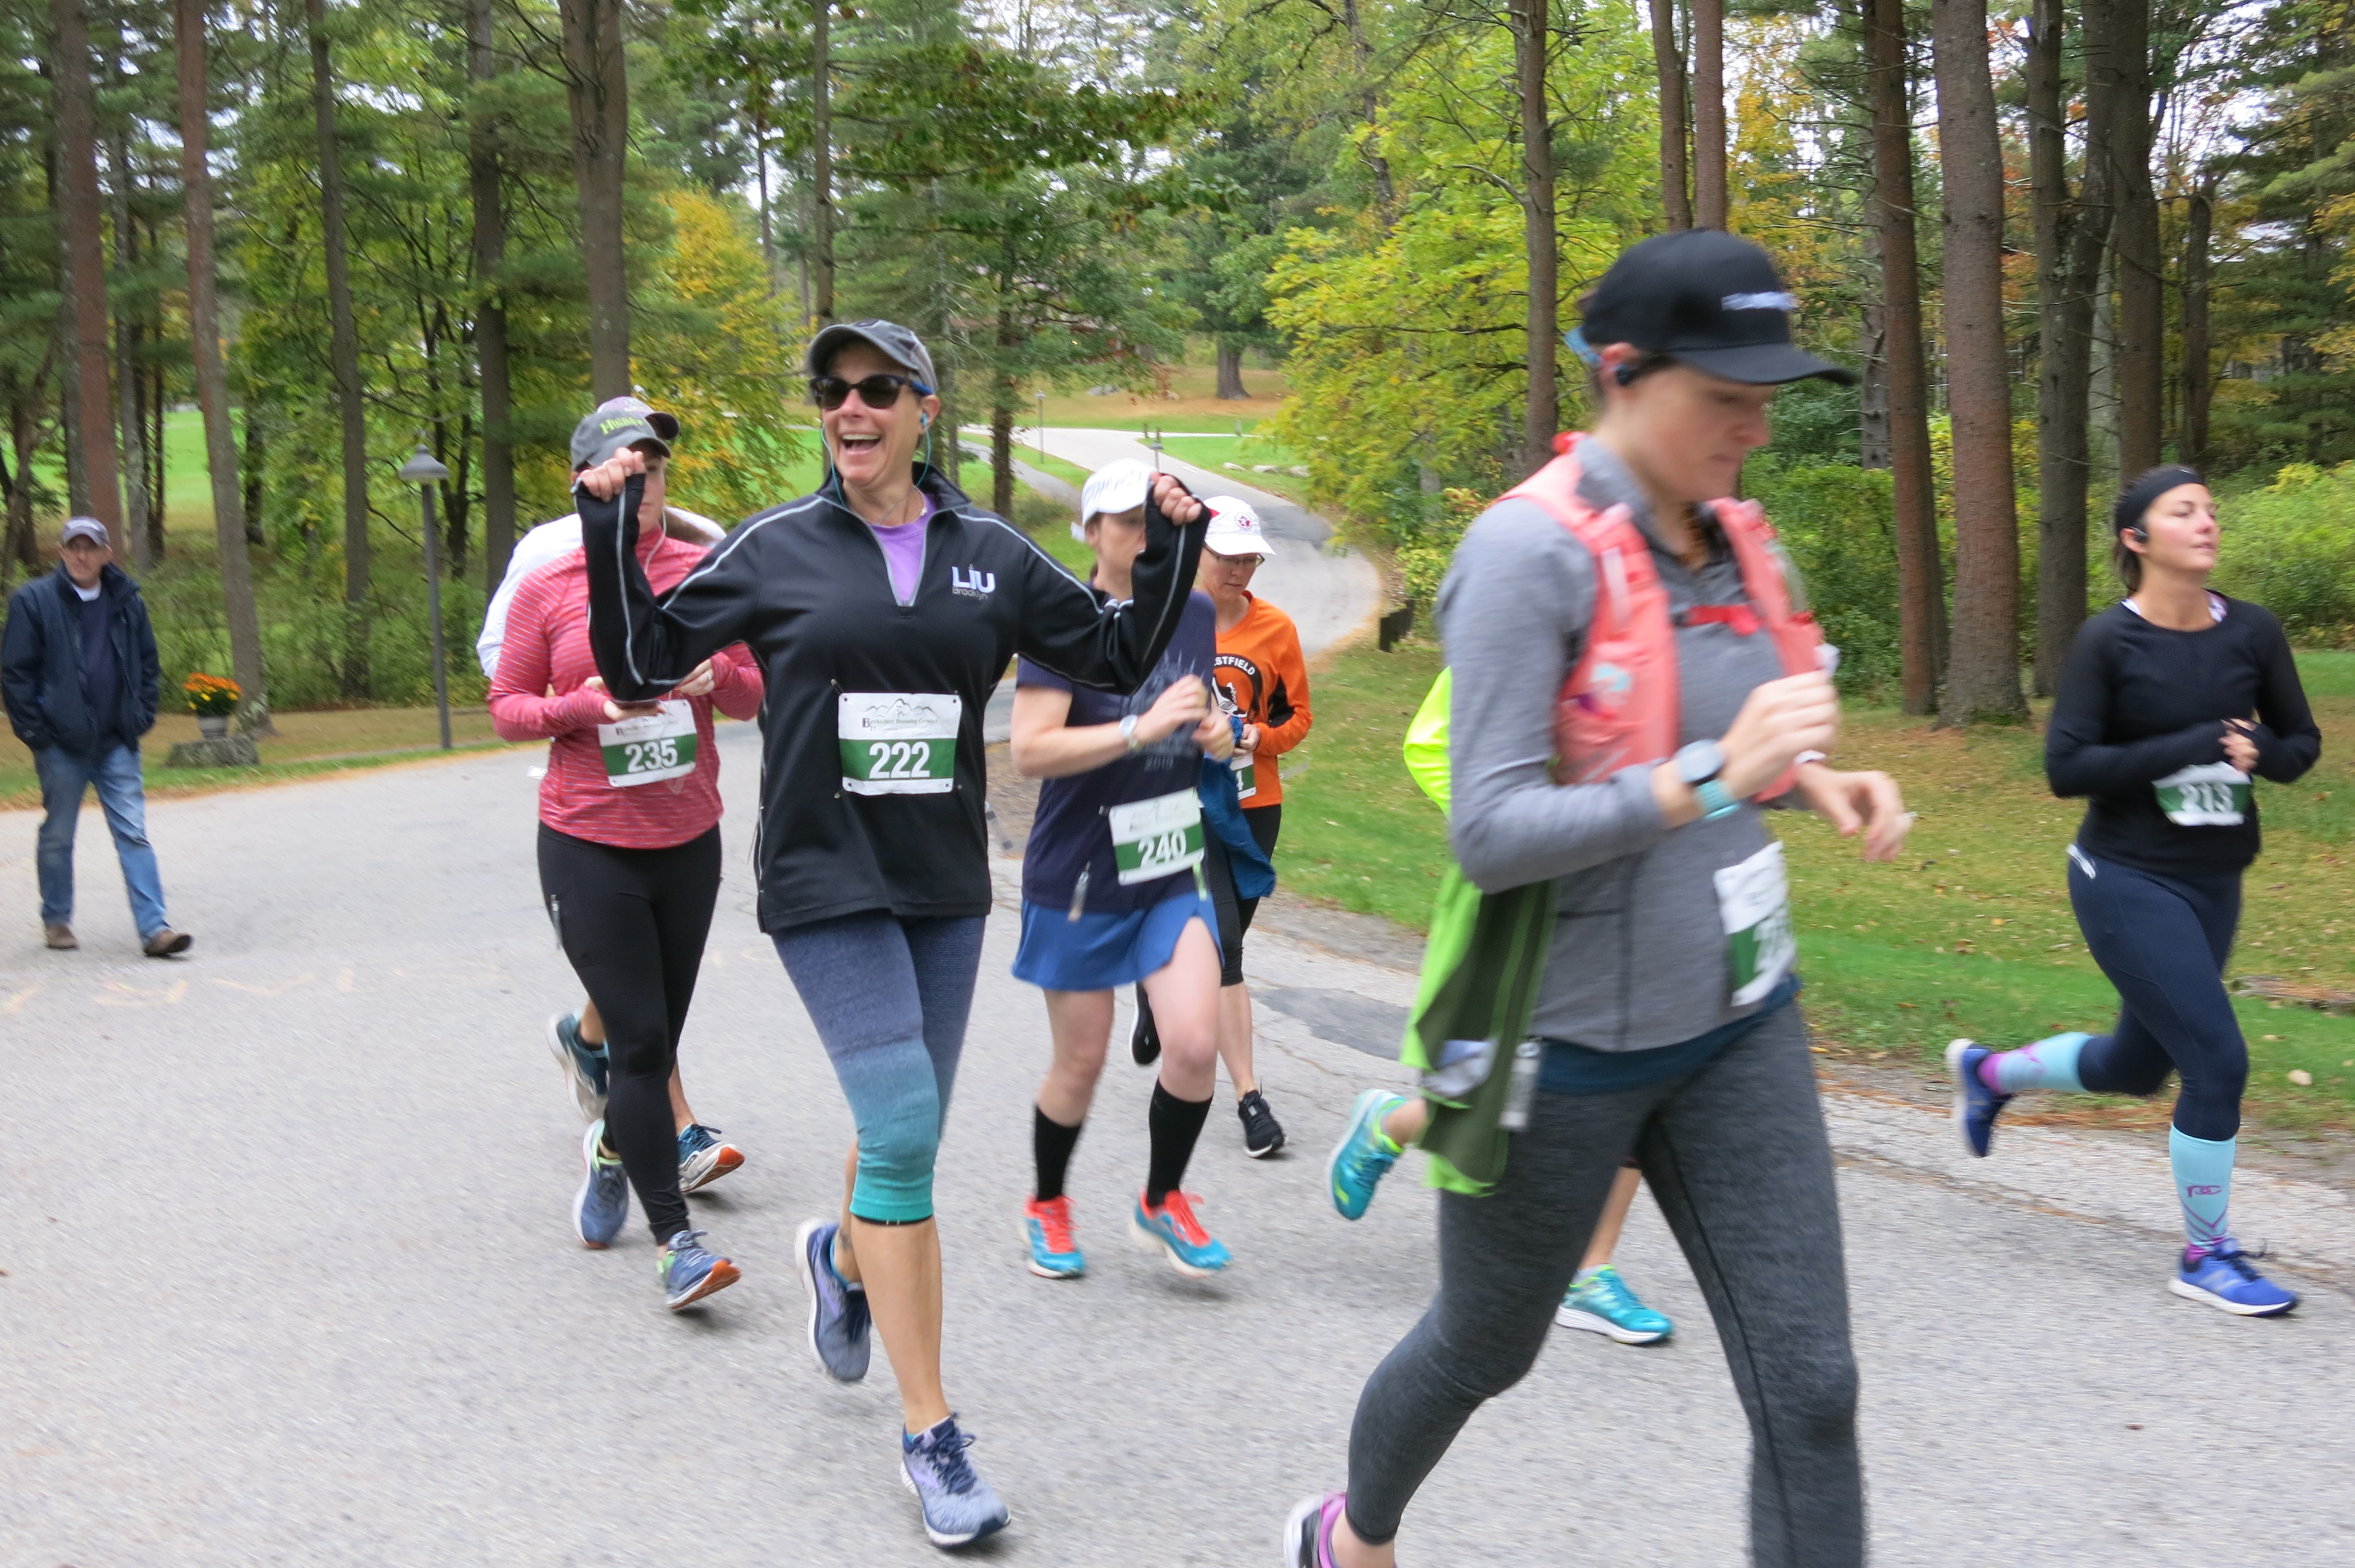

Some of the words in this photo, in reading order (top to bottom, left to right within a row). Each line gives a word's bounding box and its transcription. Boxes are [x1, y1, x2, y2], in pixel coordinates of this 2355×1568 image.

[951, 566, 995, 593] LIU
[953, 587, 987, 600] Brooklyn
[1214, 656, 1255, 675] STFIELD
[863, 717, 894, 727] Berkshire
[625, 739, 678, 773] 235
[869, 742, 930, 779] 222
[2179, 782, 2234, 813] 213
[1137, 829, 1187, 871] 240
